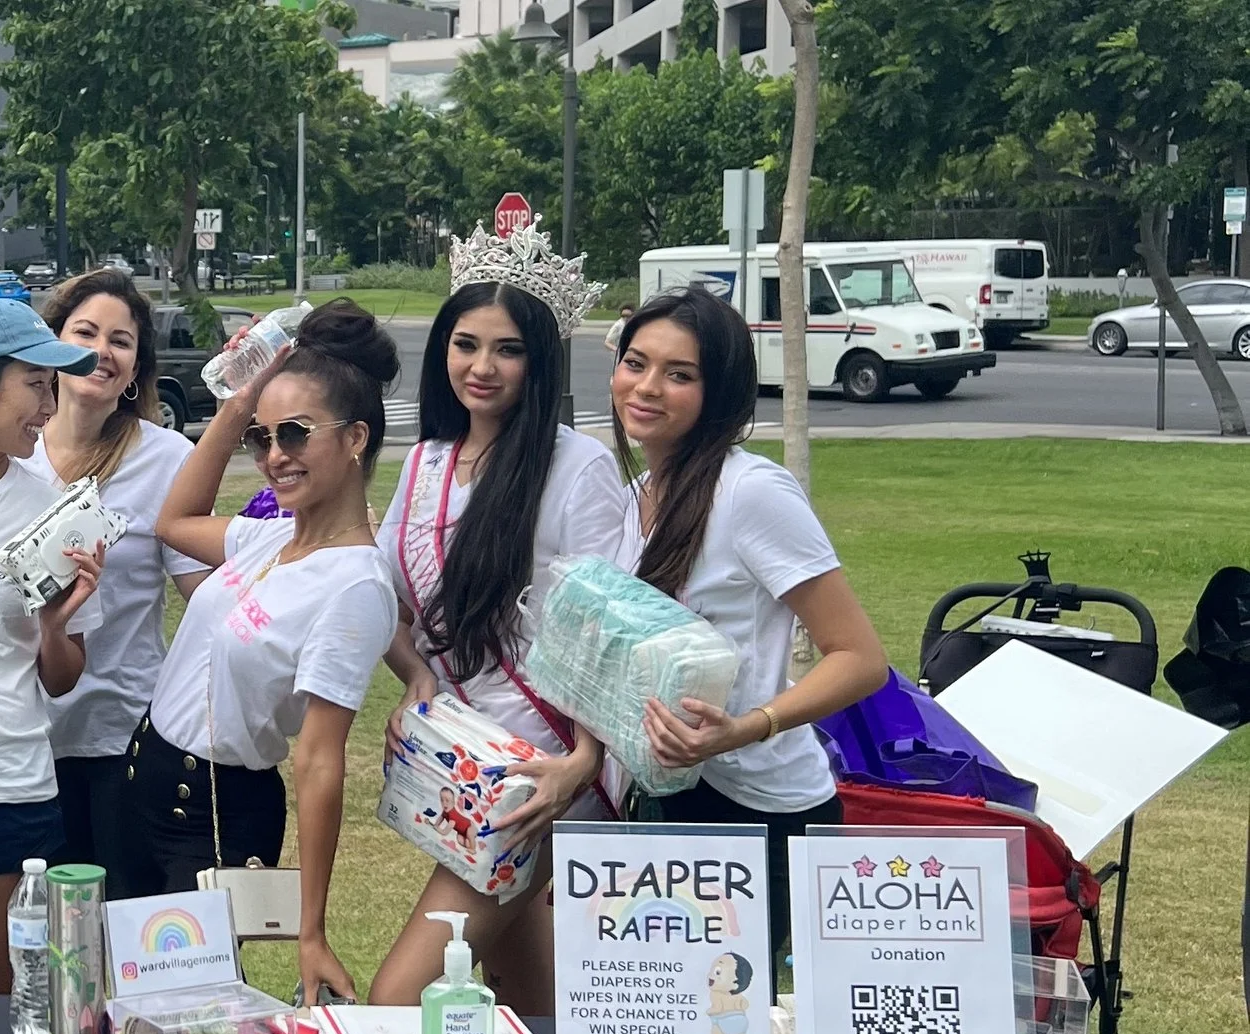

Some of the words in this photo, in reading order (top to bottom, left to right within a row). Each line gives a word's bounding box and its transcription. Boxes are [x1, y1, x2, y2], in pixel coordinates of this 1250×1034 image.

[497, 209, 529, 231] STOP
[388, 803, 399, 814] 32
[567, 858, 754, 901] DIAPER
[827, 876, 974, 910] ALOHA
[598, 915, 723, 943] RAFFLE
[826, 915, 906, 935] diaper
[920, 914, 976, 932] bank
[871, 947, 945, 962] Donation
[139, 951, 231, 974] wardvillagemoms
[582, 960, 636, 972] PLEASE
[639, 961, 683, 973] BRING
[591, 976, 651, 988] DIAPERS
[655, 977, 675, 988] OR
[570, 992, 614, 1004] WIPES
[617, 993, 632, 1004] IN
[635, 993, 663, 1004] ANY
[666, 993, 698, 1005] SIZE
[446, 1012, 474, 1021] equate
[571, 1007, 599, 1019] FOR
[602, 1008, 613, 1019] A
[616, 1008, 675, 1021] CHANCE
[677, 1010, 698, 1021] TO
[446, 1023, 470, 1031] Hand
[589, 1024, 618, 1034] WIN
